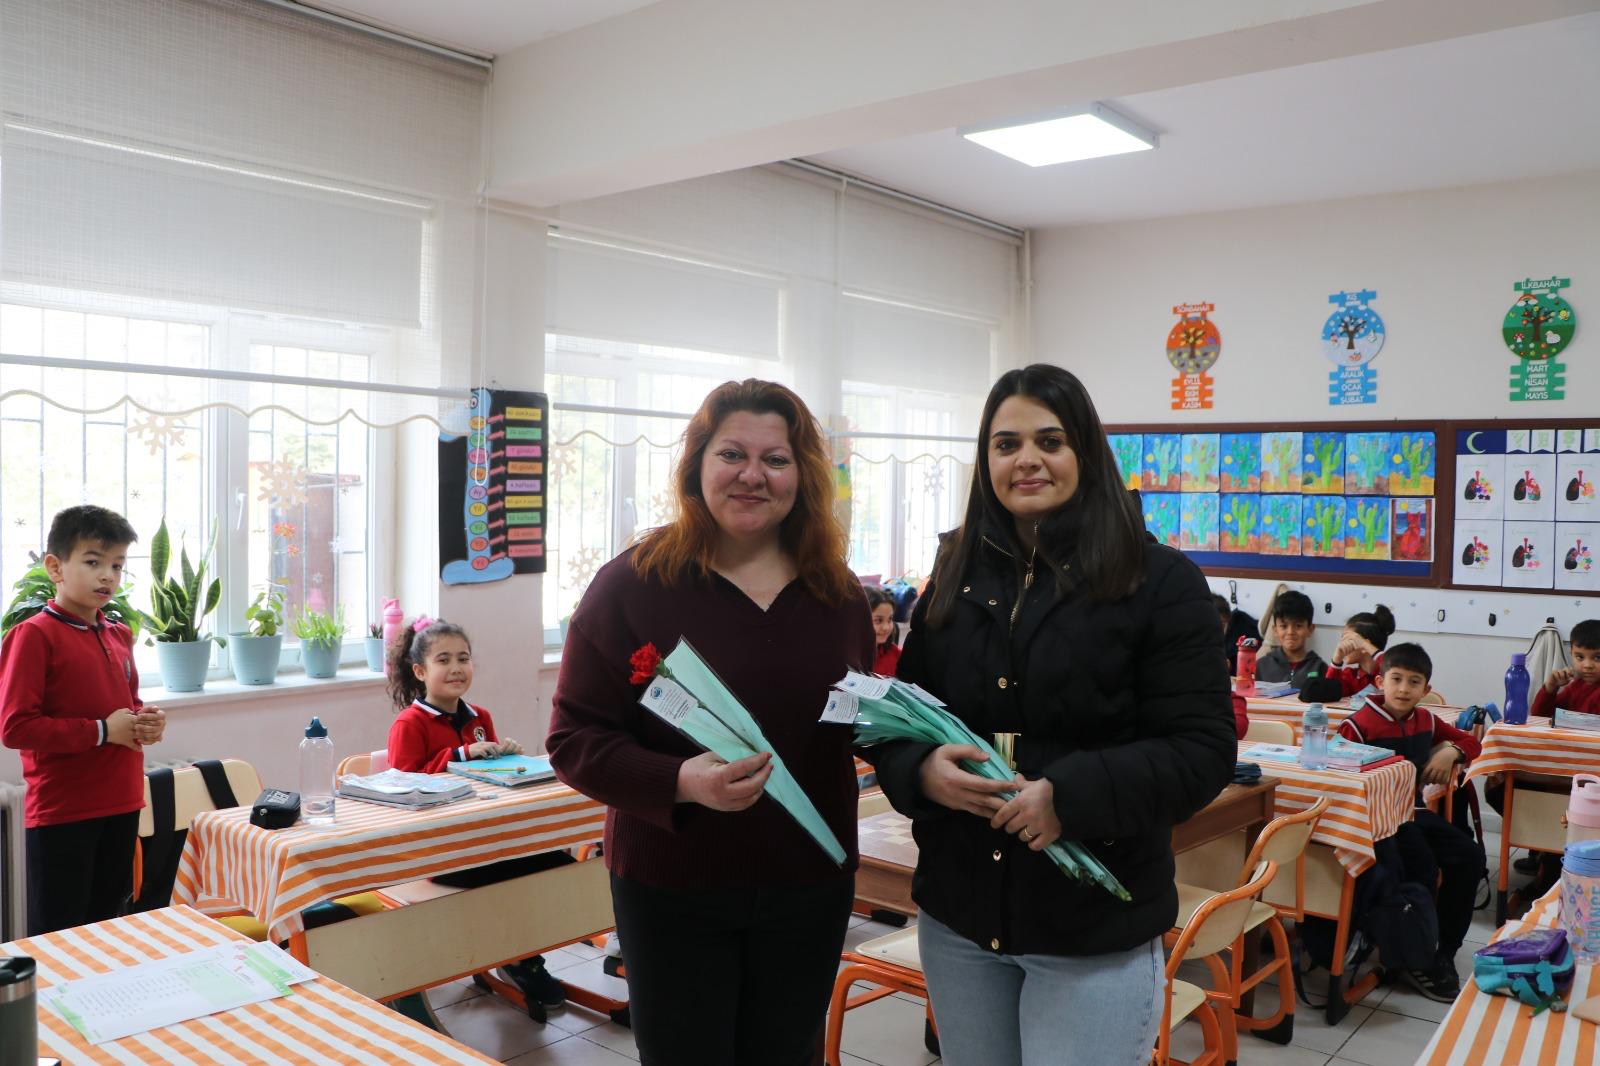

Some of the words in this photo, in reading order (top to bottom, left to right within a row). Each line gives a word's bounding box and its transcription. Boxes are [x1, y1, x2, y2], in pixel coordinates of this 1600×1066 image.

[1521, 280, 1561, 289] İLKBAHAR
[1526, 364, 1549, 372] MART
[1340, 370, 1365, 378] ARALIK
[1525, 378, 1548, 386] NİSAN
[1525, 392, 1548, 400] MAYIS
